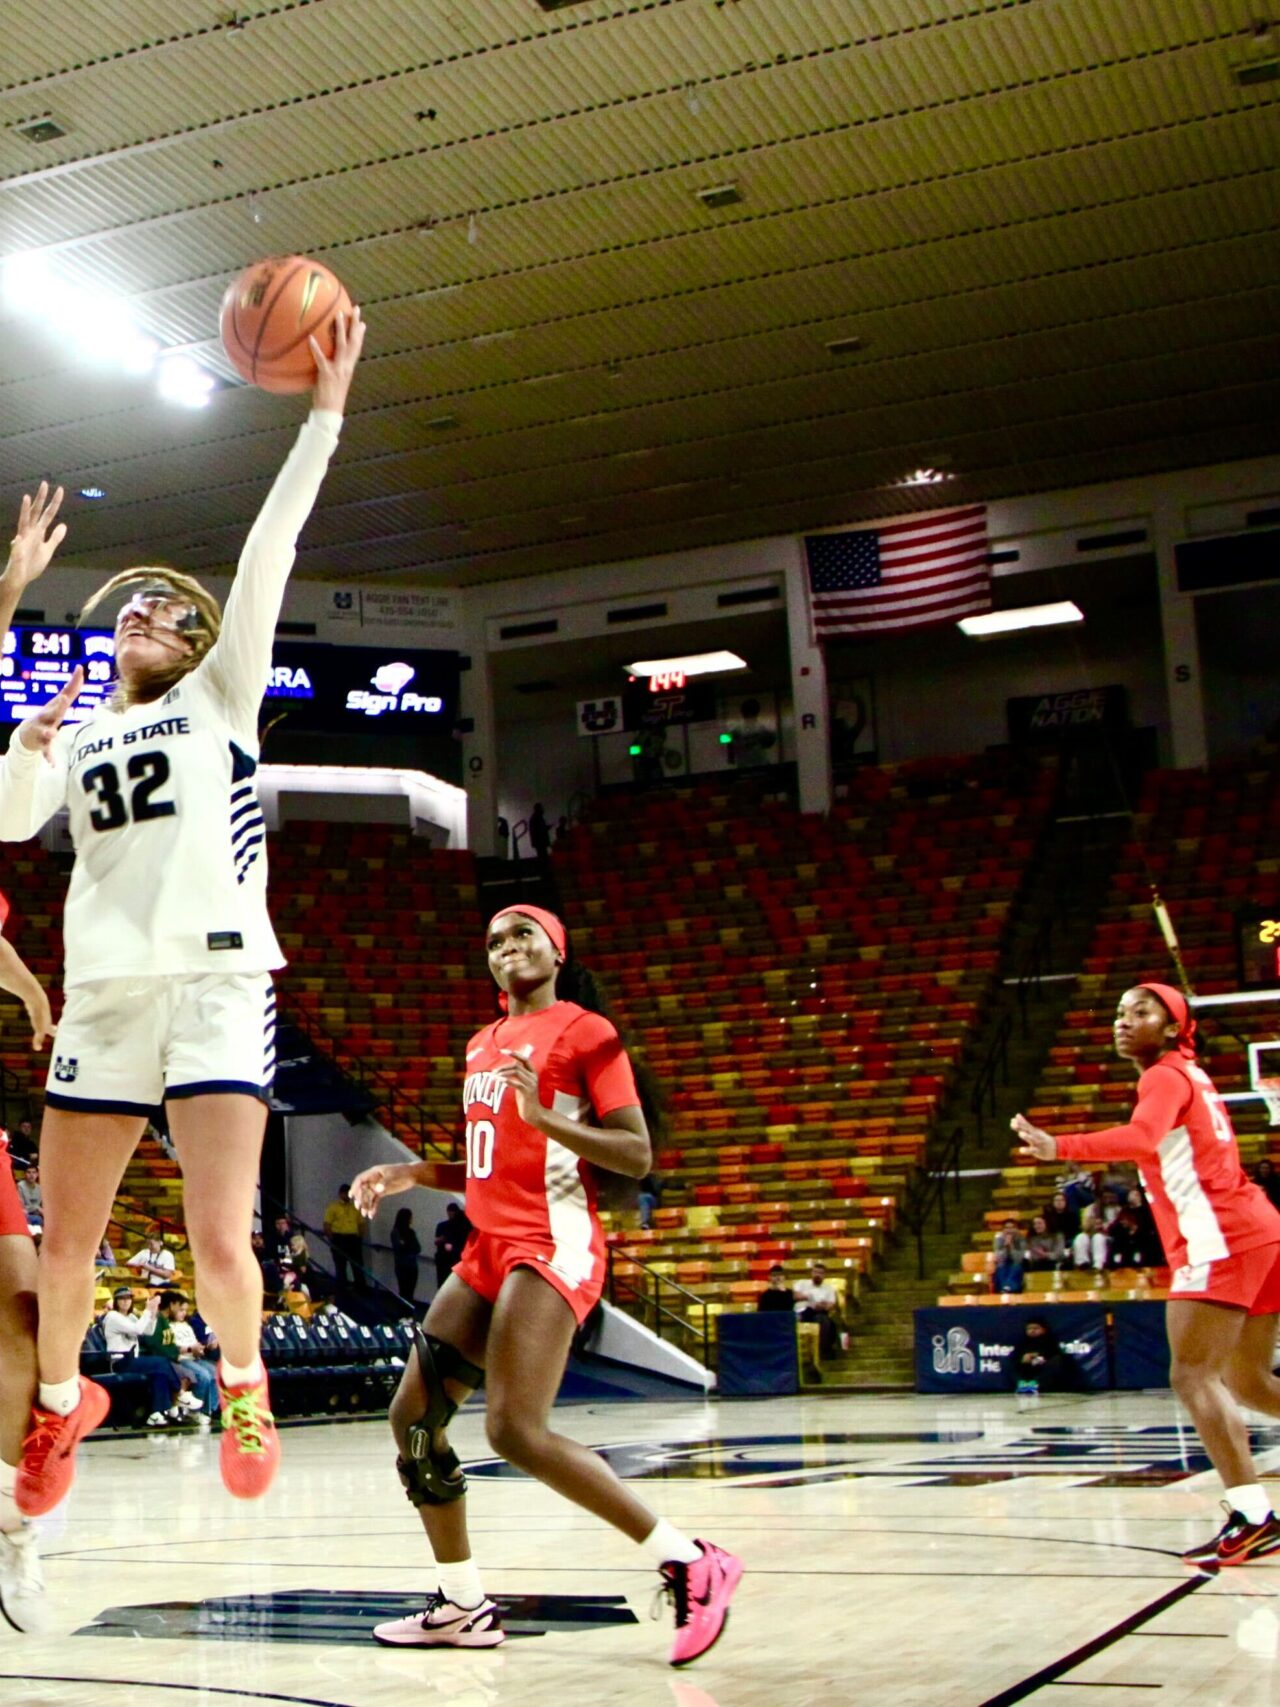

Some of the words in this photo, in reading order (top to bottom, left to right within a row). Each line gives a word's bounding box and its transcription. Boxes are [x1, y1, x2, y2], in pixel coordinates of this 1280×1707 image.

[32, 632, 70, 655] 2:41
[1174, 664, 1190, 682] S
[345, 690, 398, 716] Sign
[400, 692, 443, 713] Pro
[122, 716, 191, 745] STATE
[802, 713, 816, 730] R
[81, 749, 177, 833] 32
[465, 1119, 495, 1179] 10
